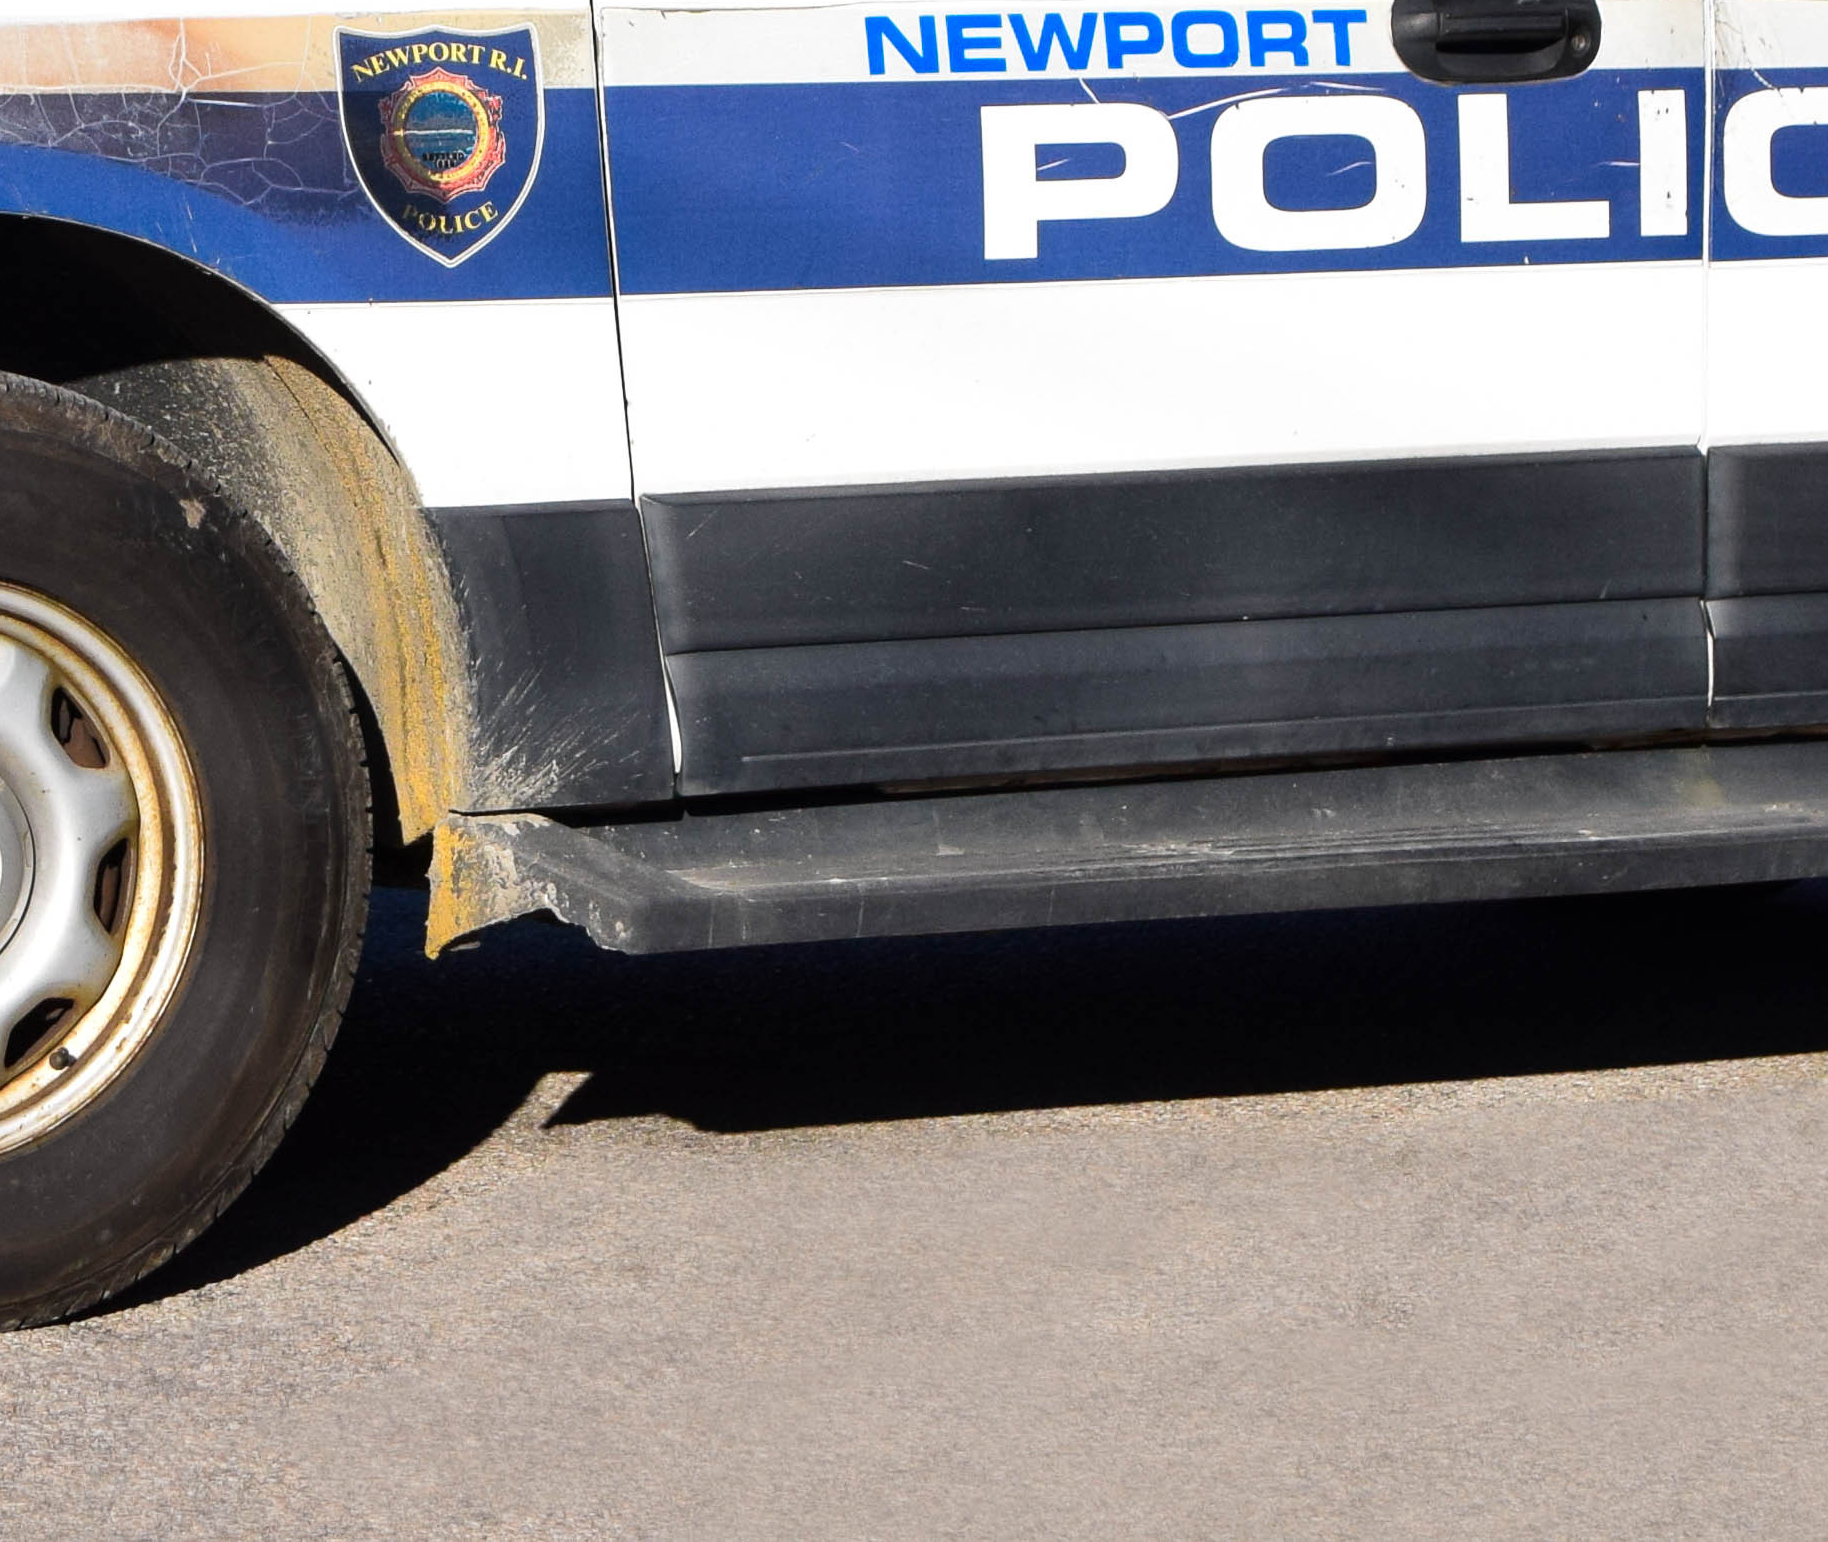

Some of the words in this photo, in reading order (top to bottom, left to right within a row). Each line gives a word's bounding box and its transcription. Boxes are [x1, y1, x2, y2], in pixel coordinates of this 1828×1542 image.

[864, 9, 1367, 75] NEWPORT
[352, 43, 485, 82] NEWPORT
[489, 50, 528, 80] R.I.
[405, 202, 498, 234] POLICE
